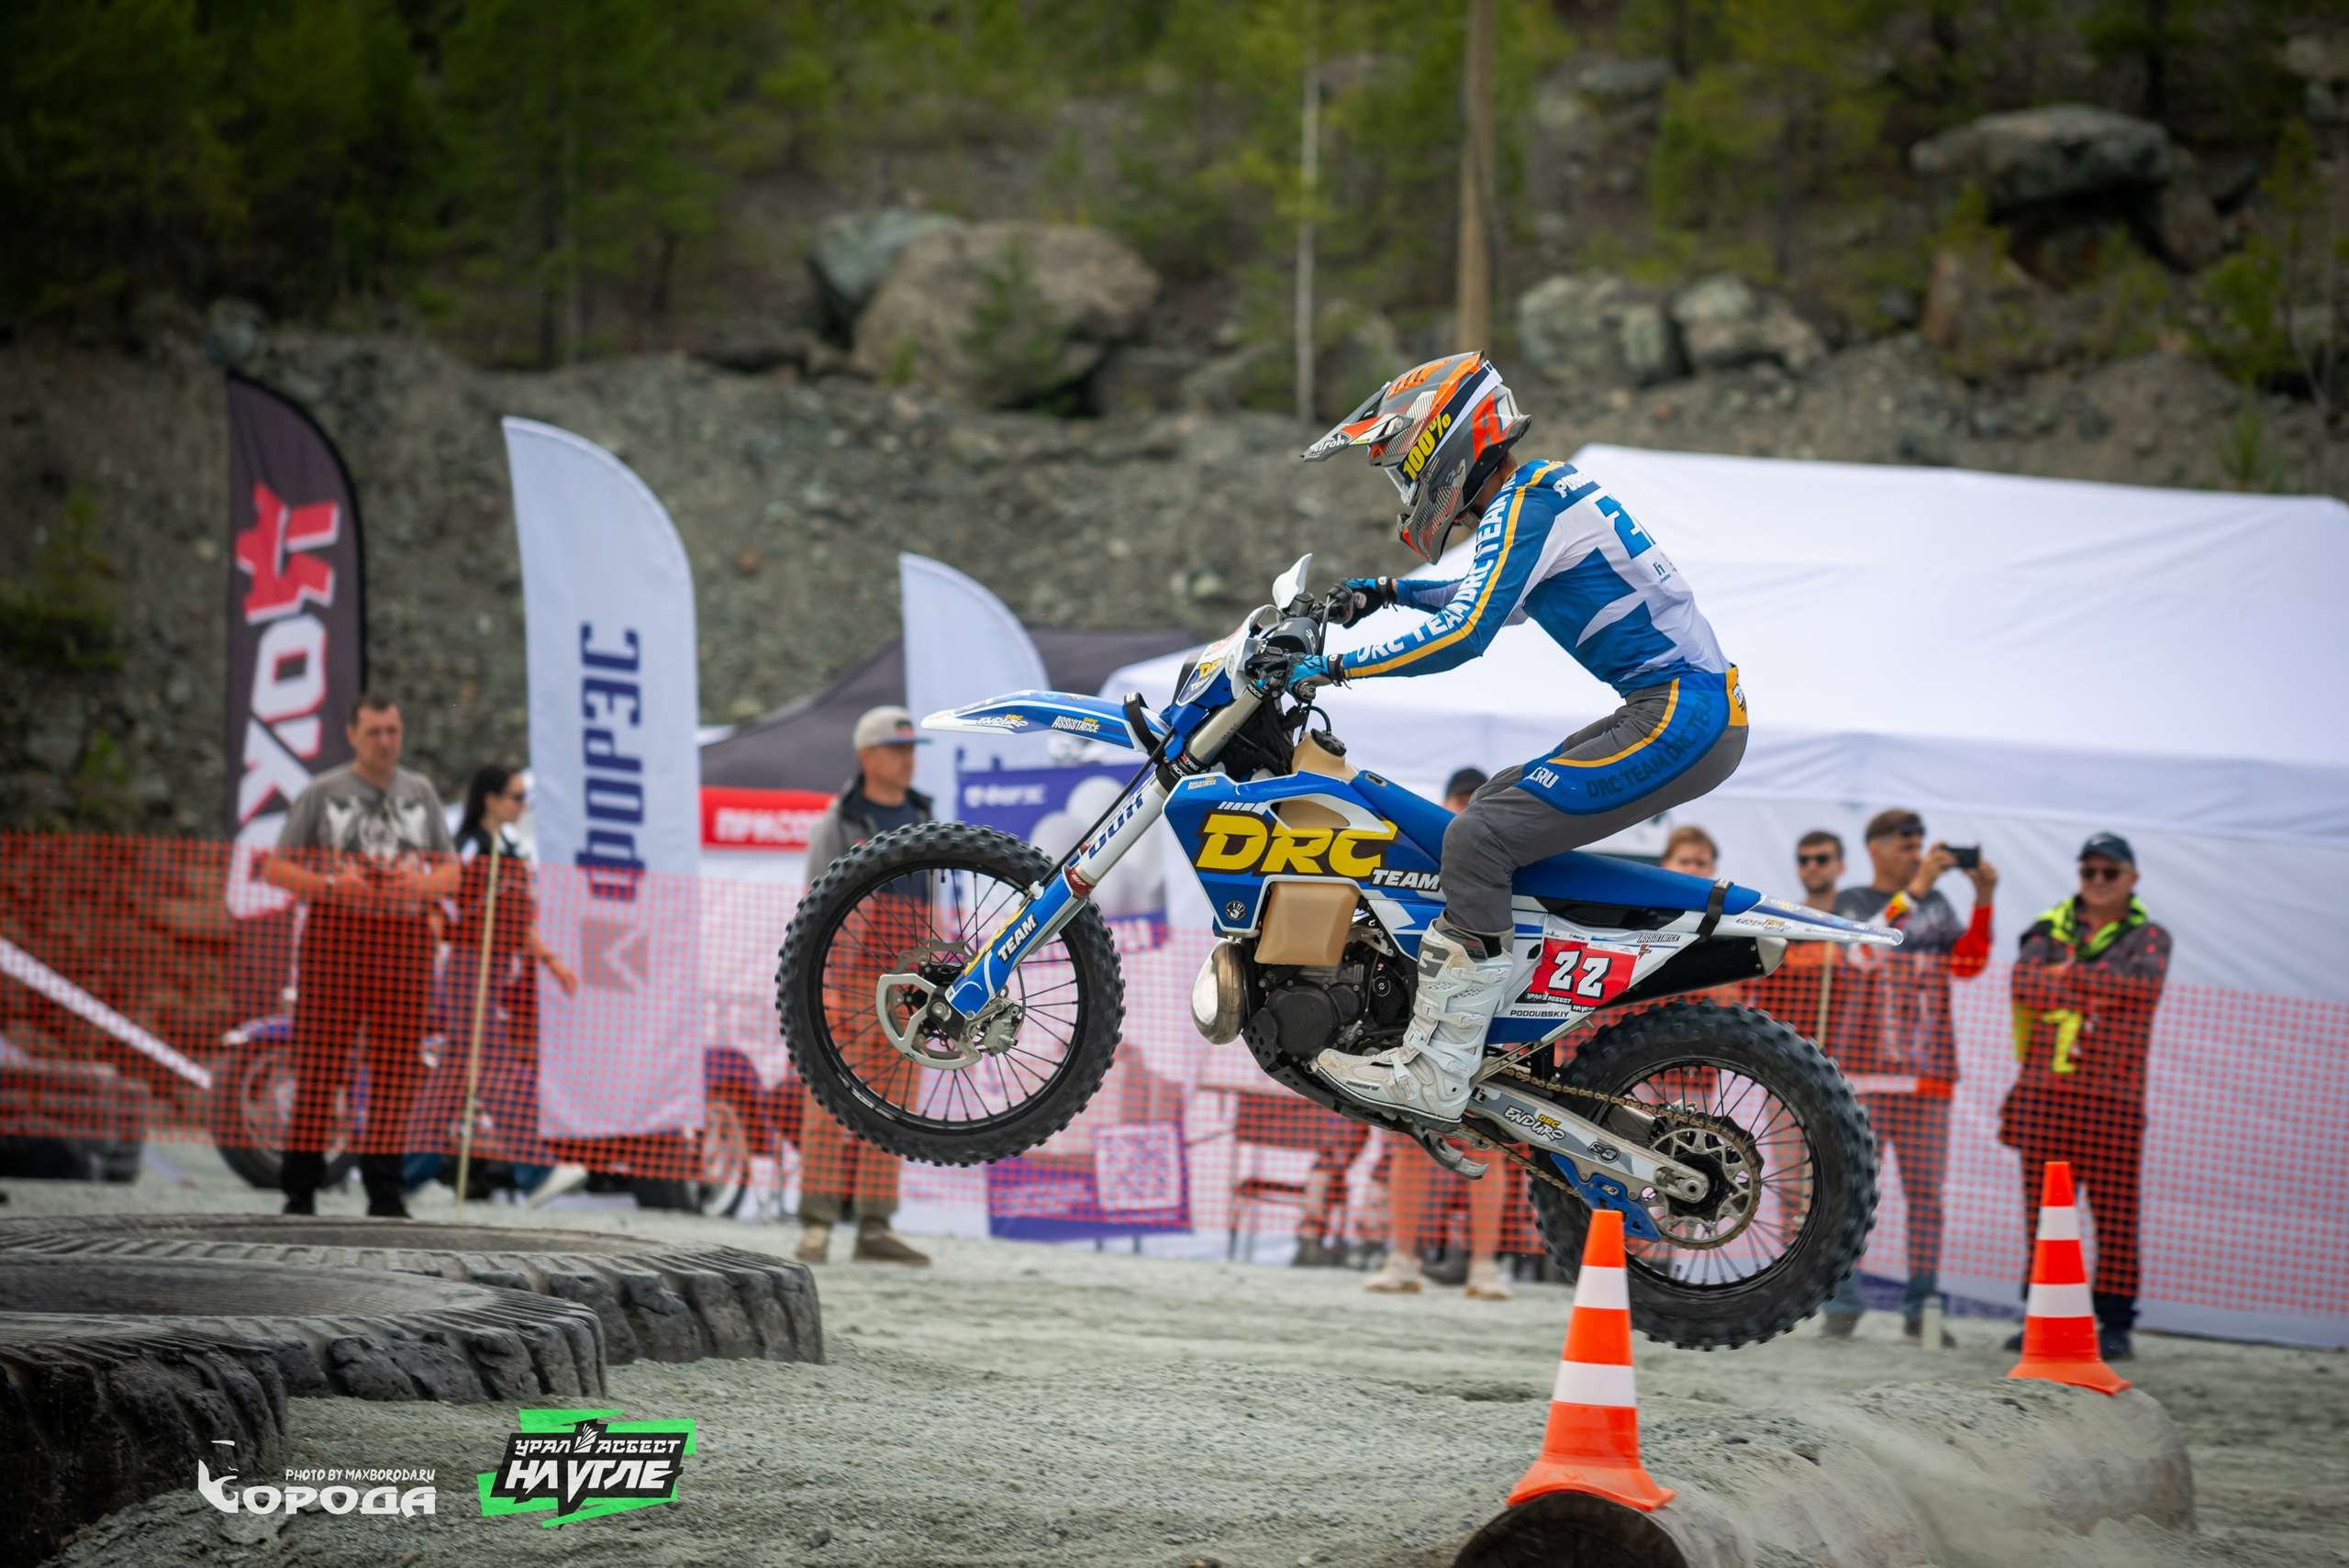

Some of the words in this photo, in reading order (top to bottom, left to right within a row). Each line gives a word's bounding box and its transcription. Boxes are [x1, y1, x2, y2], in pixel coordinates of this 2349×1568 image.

[1403, 413, 1452, 481] 100%
[1410, 602, 1471, 642] TEAM
[1458, 559, 1495, 602] DRC
[1051, 715, 1100, 733] ASSISTANCE
[575, 623, 645, 903] ФОРЭС
[1586, 777, 1623, 798] DRC
[1620, 755, 1669, 789] TEAM
[1664, 729, 1698, 762] DRC
[1195, 813, 1398, 877] DRC
[1372, 869, 1441, 890] TEAM
[996, 913, 1037, 962] TEAM
[1548, 950, 1612, 998] 22
[1504, 1106, 1565, 1140] ENDURO
[1538, 1114, 1562, 1128] DRC
